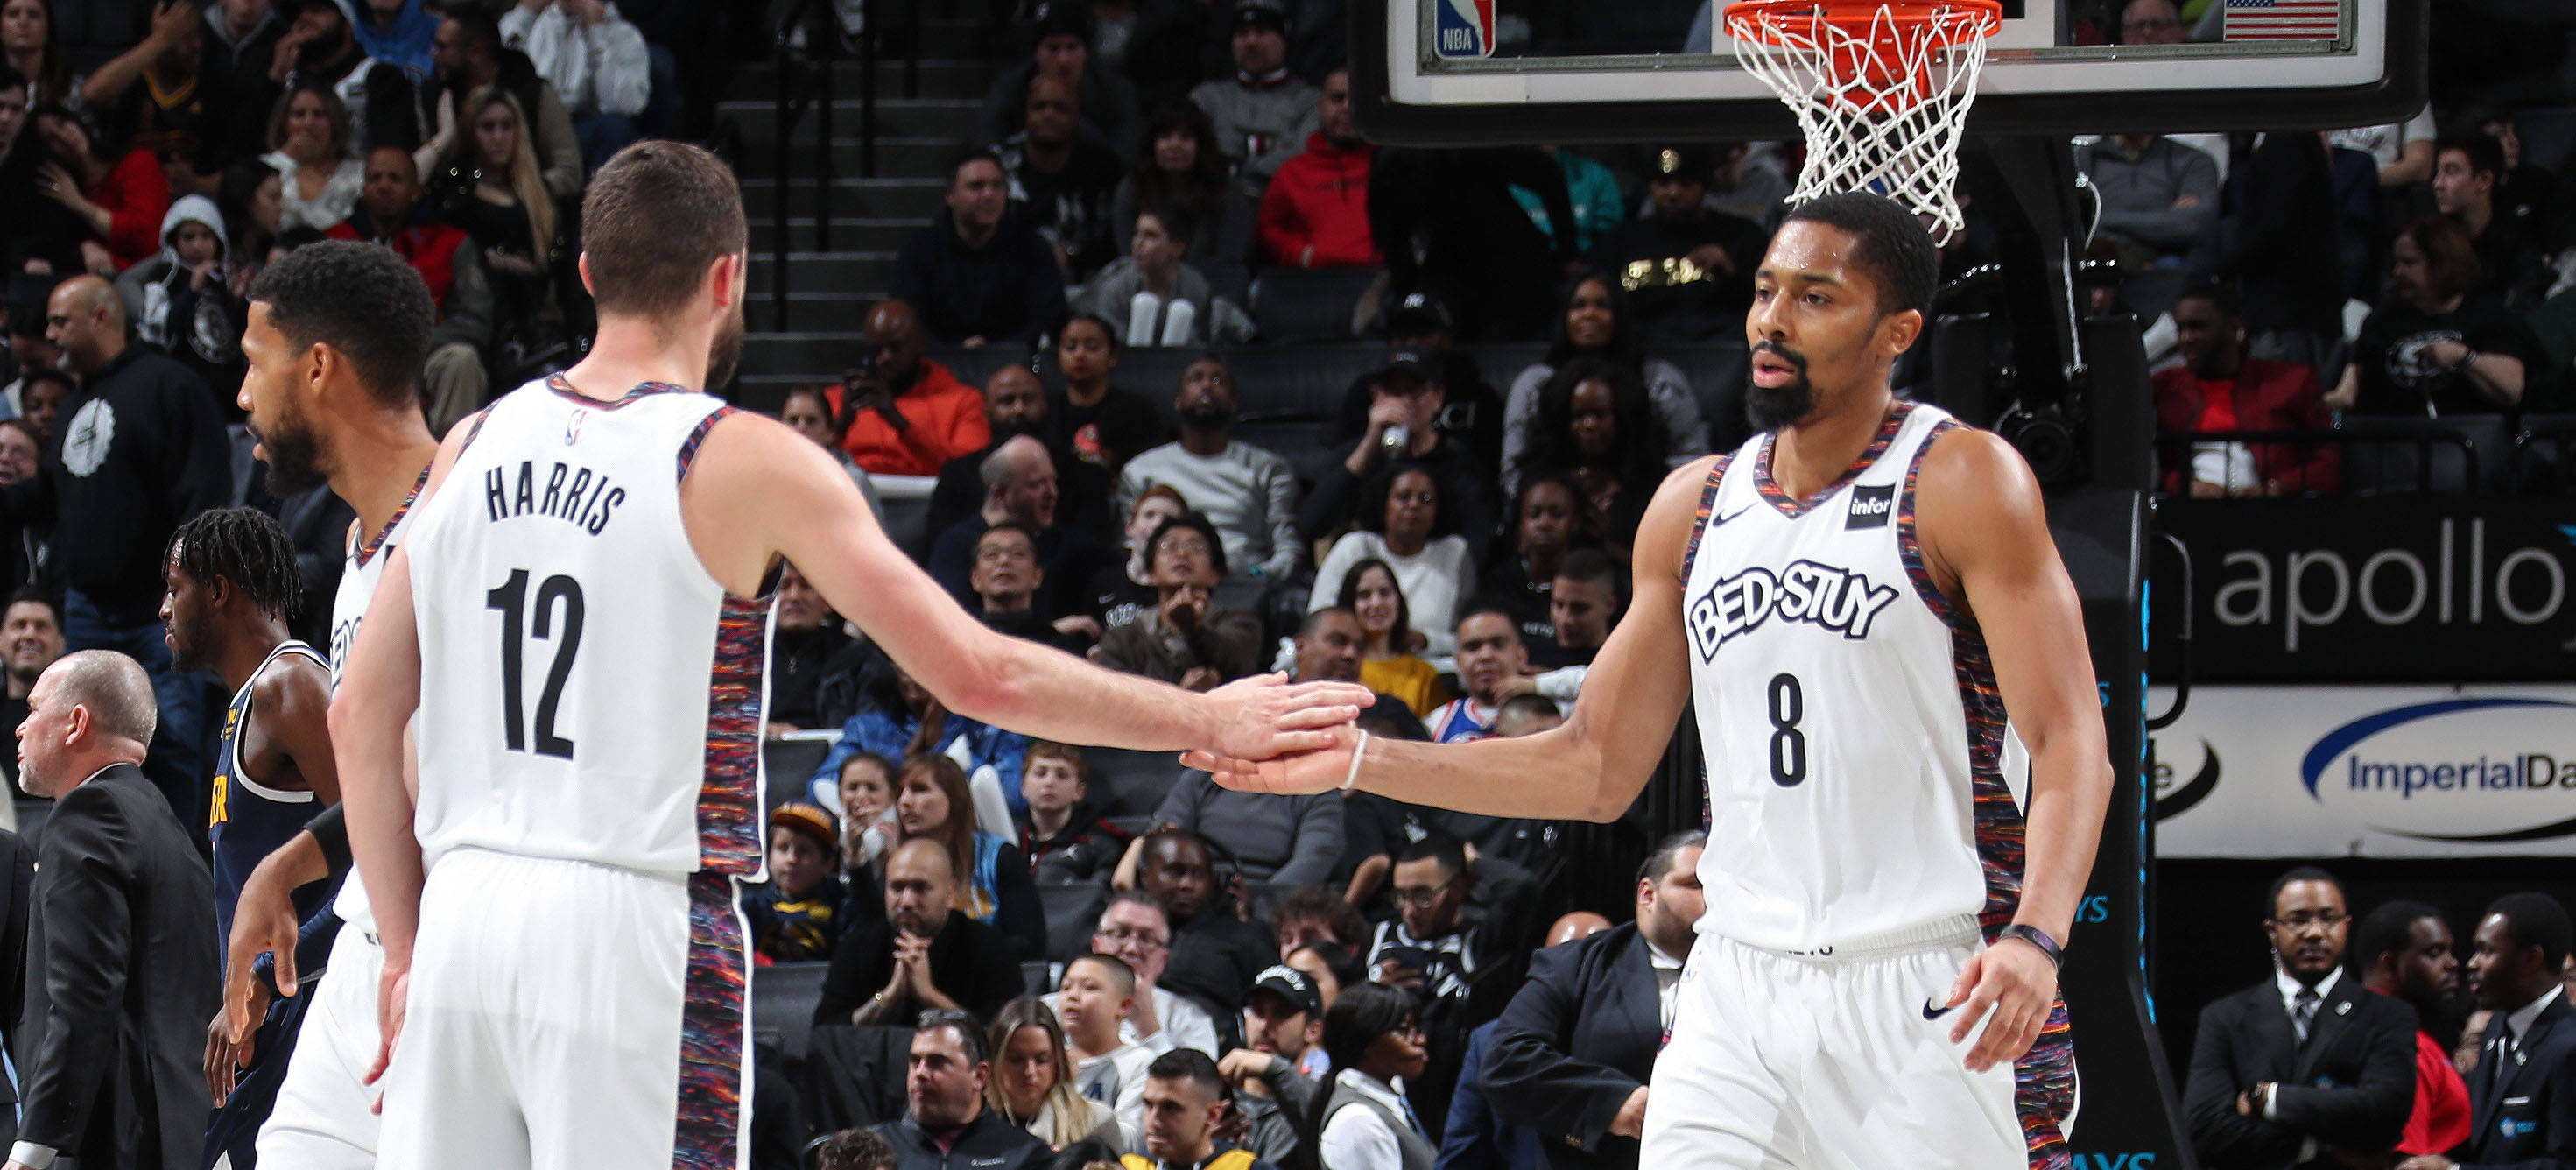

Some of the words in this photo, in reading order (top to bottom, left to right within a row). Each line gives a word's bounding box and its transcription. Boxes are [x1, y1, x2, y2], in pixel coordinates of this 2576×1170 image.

[1442, 27, 1473, 51] NBA
[486, 461, 626, 537] HARRIS
[1850, 497, 1890, 516] infor
[1689, 559, 1899, 665] BED-STUY
[2214, 518, 2565, 653] apollo
[486, 568, 587, 762] 12
[1767, 673, 1807, 788] 8
